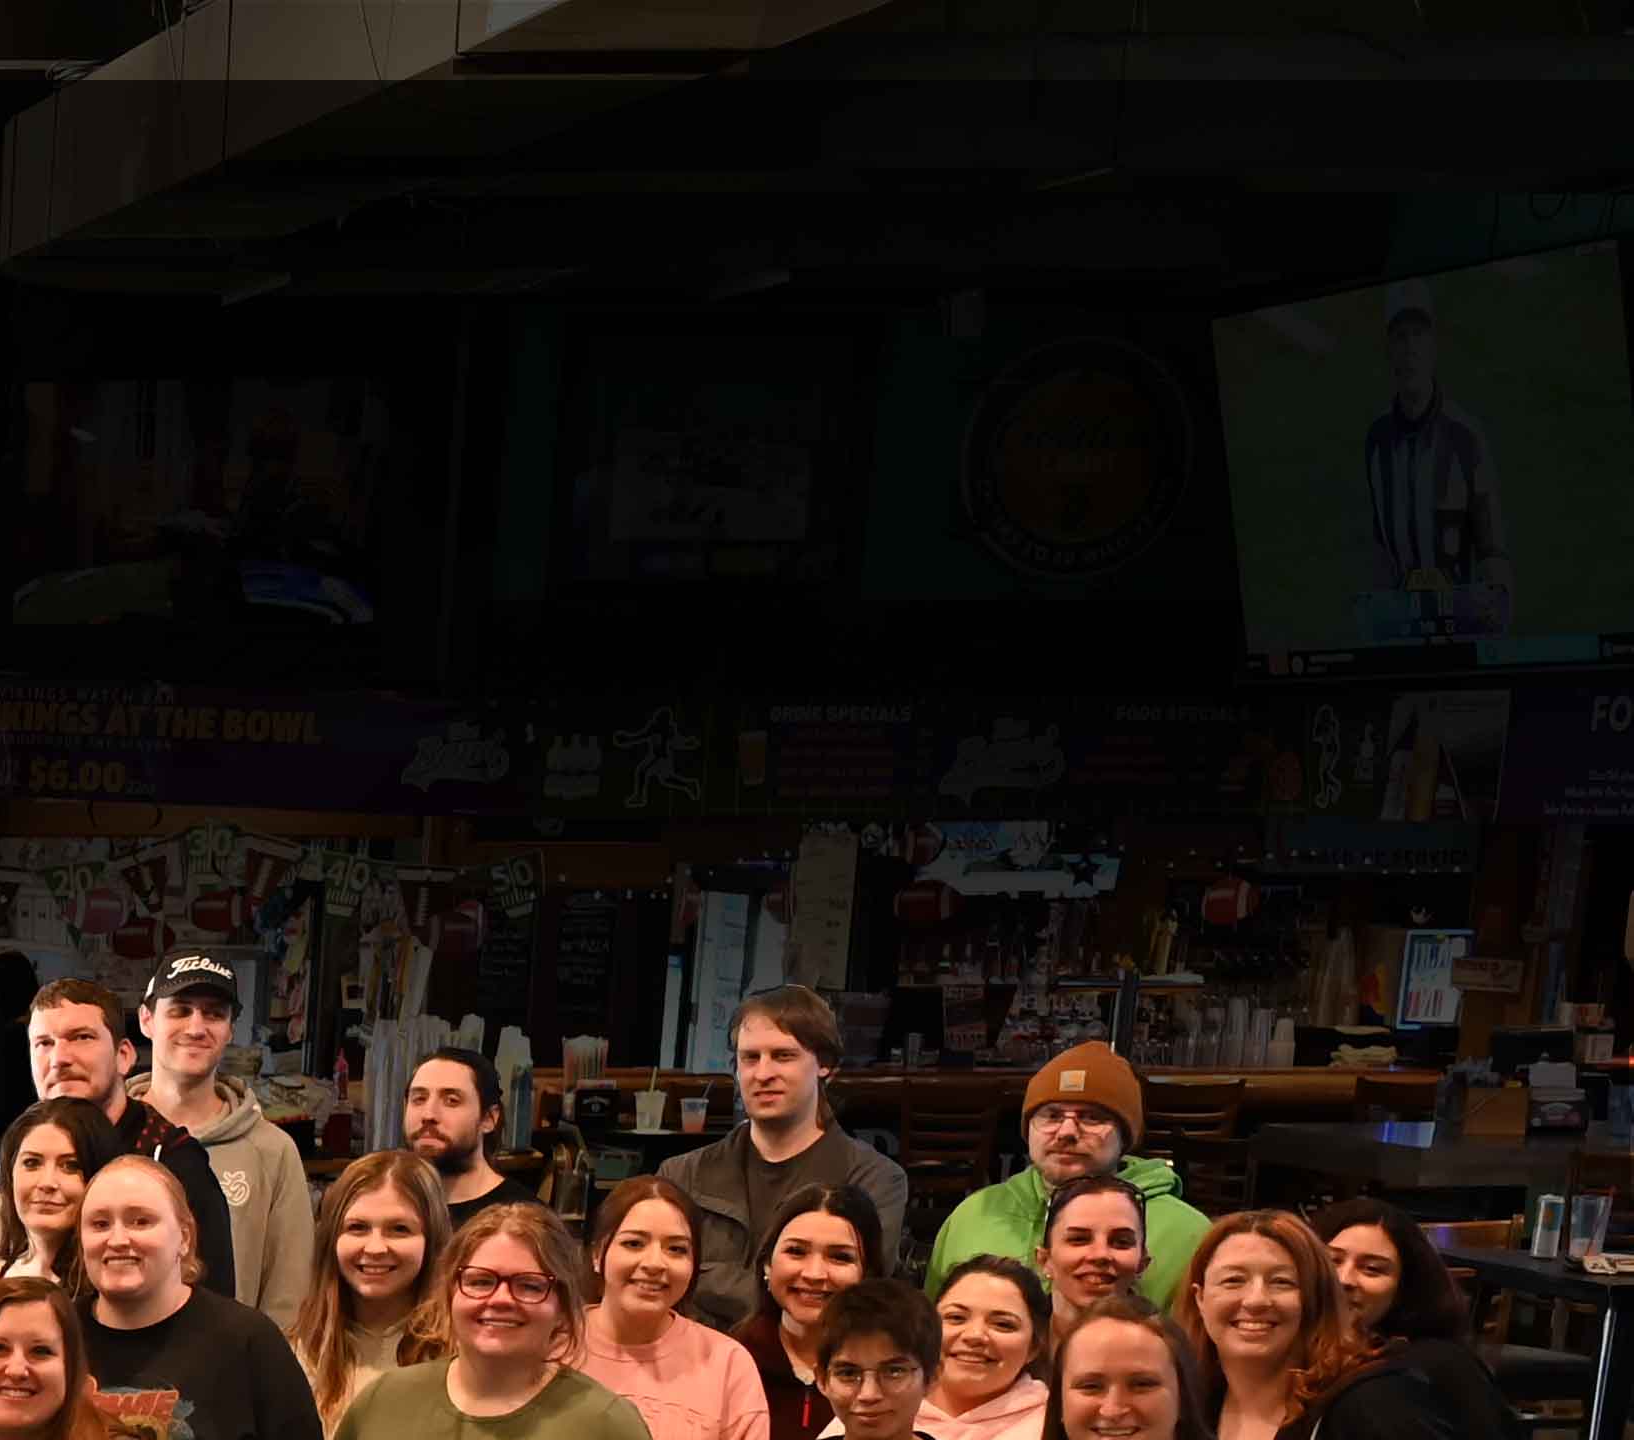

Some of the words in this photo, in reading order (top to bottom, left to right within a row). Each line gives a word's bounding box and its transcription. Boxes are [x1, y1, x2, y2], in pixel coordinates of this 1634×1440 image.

[104, 704, 143, 737] AT
[152, 705, 220, 740] THE
[221, 710, 321, 744] BOWL
[826, 705, 912, 722] SPECIALS
[29, 757, 126, 793] $6.00
[189, 829, 236, 857] 30
[50, 866, 94, 896] 20
[324, 862, 368, 891] 40
[492, 859, 532, 888] 50
